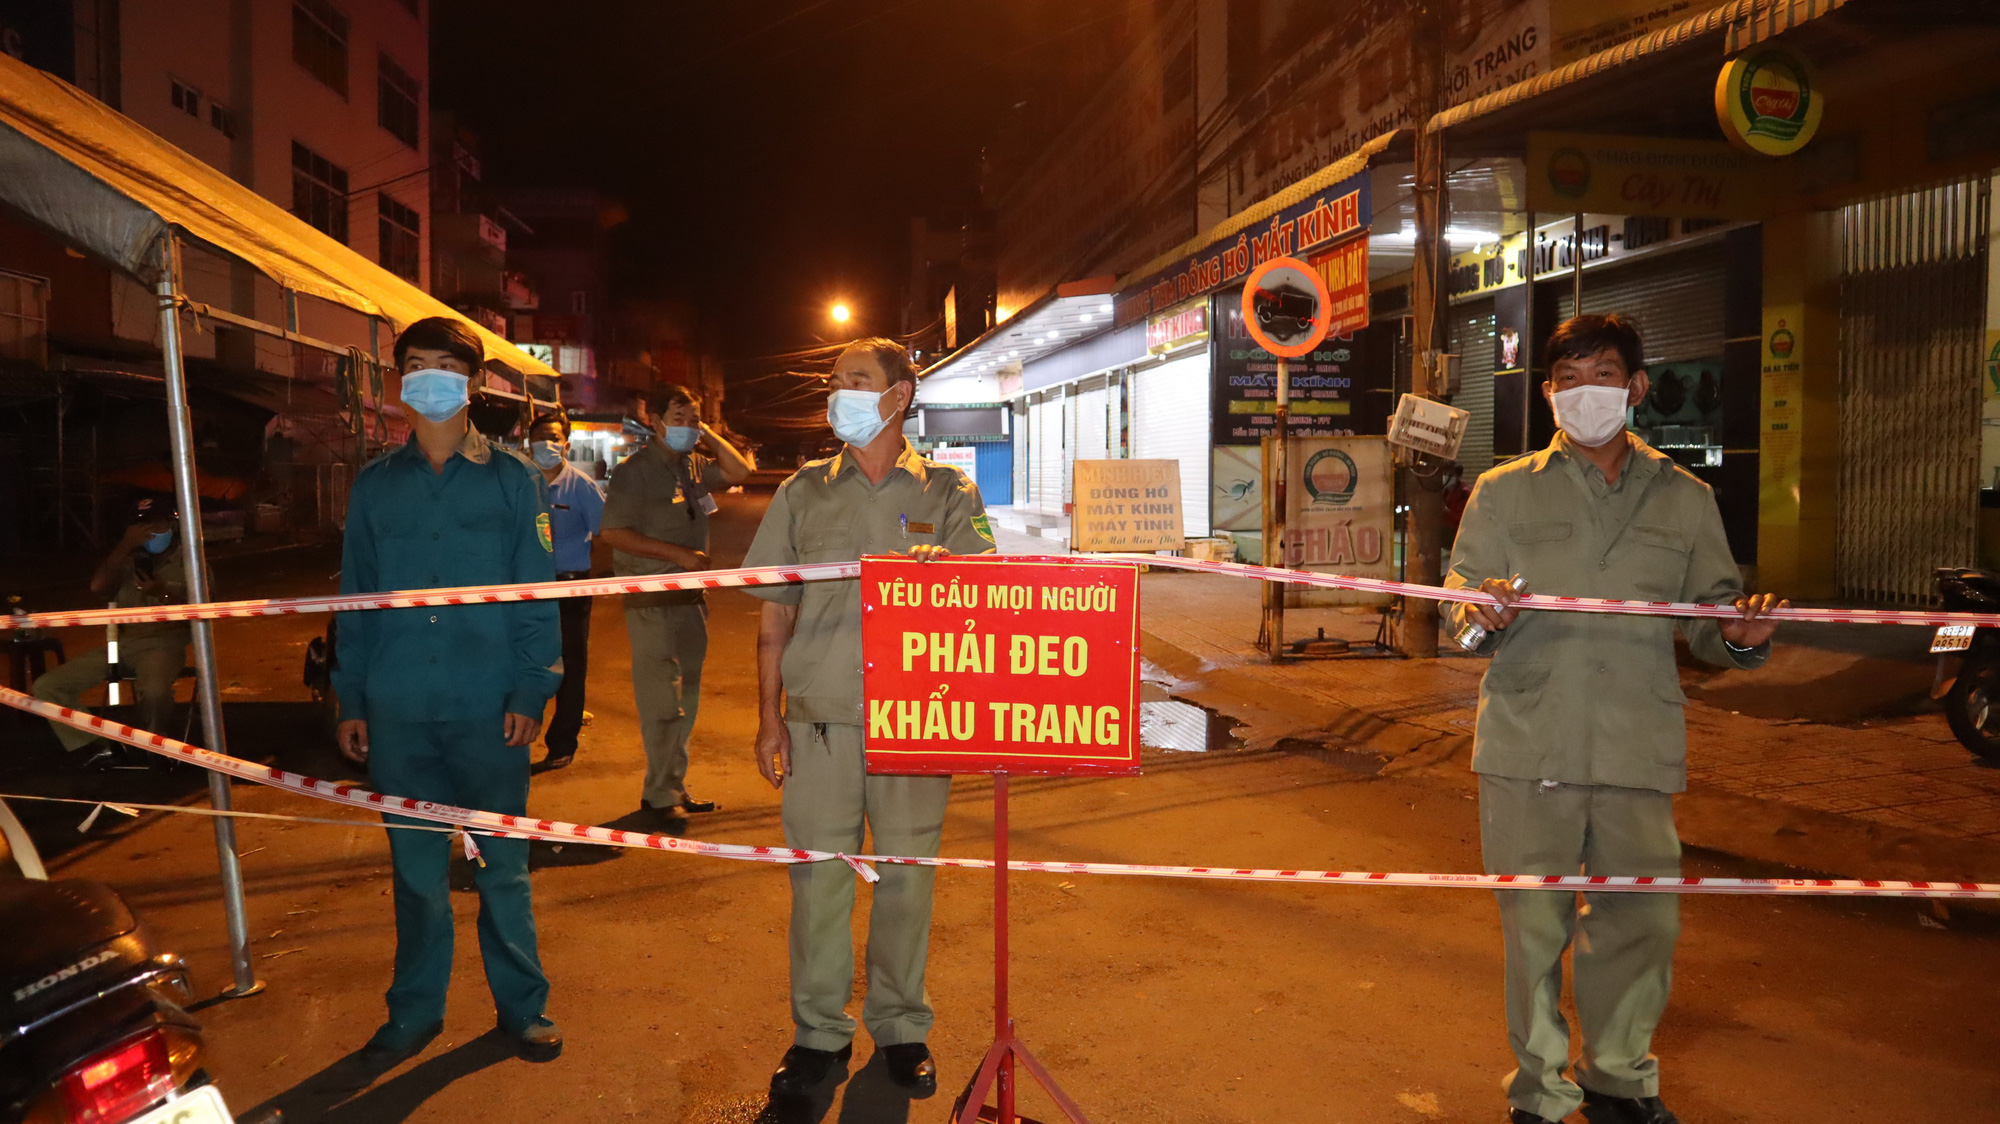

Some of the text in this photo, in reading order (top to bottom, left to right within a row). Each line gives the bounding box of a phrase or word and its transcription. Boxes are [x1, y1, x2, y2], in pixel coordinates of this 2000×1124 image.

[1474, 26, 1537, 79] TRANG
[1178, 257, 1221, 299] ĐỒNG
[1223, 233, 1249, 281] HỒ
[1252, 215, 1294, 268] MẮT
[1297, 189, 1362, 252] KÍNH
[1229, 373, 1351, 388] MẮT KÍNH
[1131, 502, 1174, 515] KÍNH
[1145, 484, 1169, 499] HỒ
[1134, 519, 1175, 531] TÍNH
[1285, 519, 1381, 566] CHÁO
[877, 576, 1117, 615] YÊU CẦU MỌI NGƯỜI
[902, 619, 1088, 677] PHẢI ĐEO
[869, 683, 1120, 746] KHẨU TRANG
[13, 949, 123, 1003] HONDA
